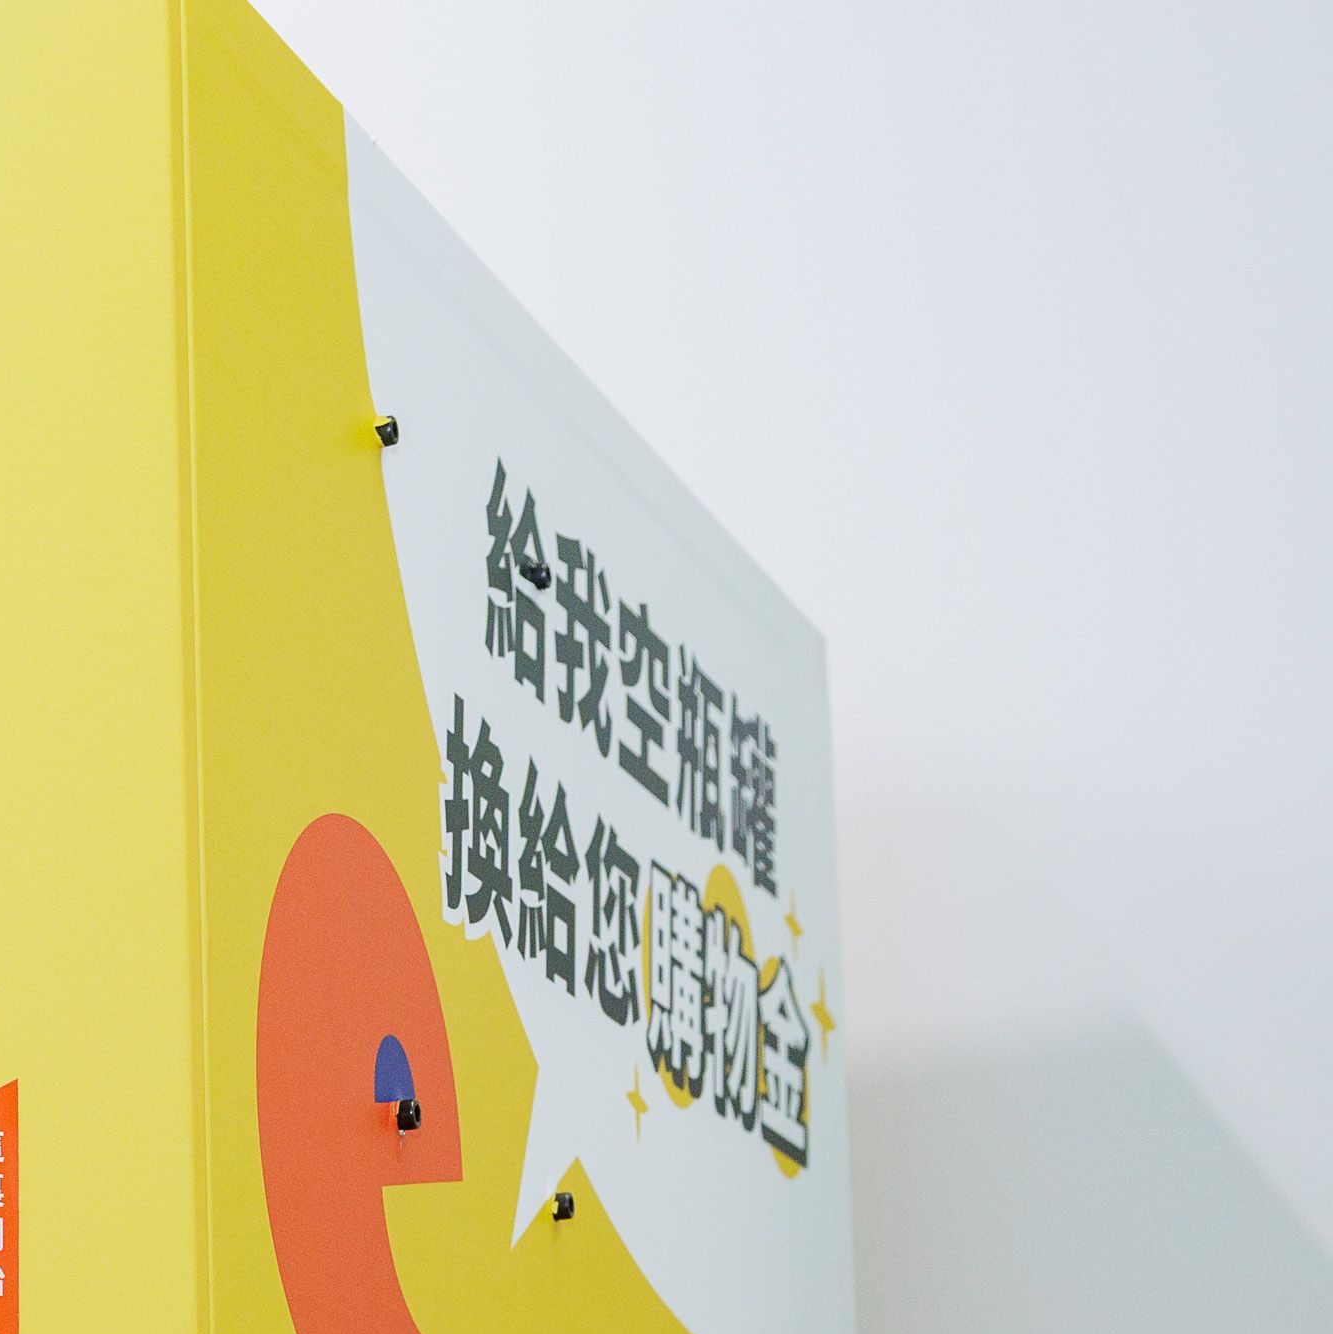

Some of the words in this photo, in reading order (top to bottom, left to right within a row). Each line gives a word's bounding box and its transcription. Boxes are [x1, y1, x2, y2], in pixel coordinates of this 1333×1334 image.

[483, 456, 780, 897] 給我空瓶罐
[440, 691, 811, 1171] 換給您購物金
